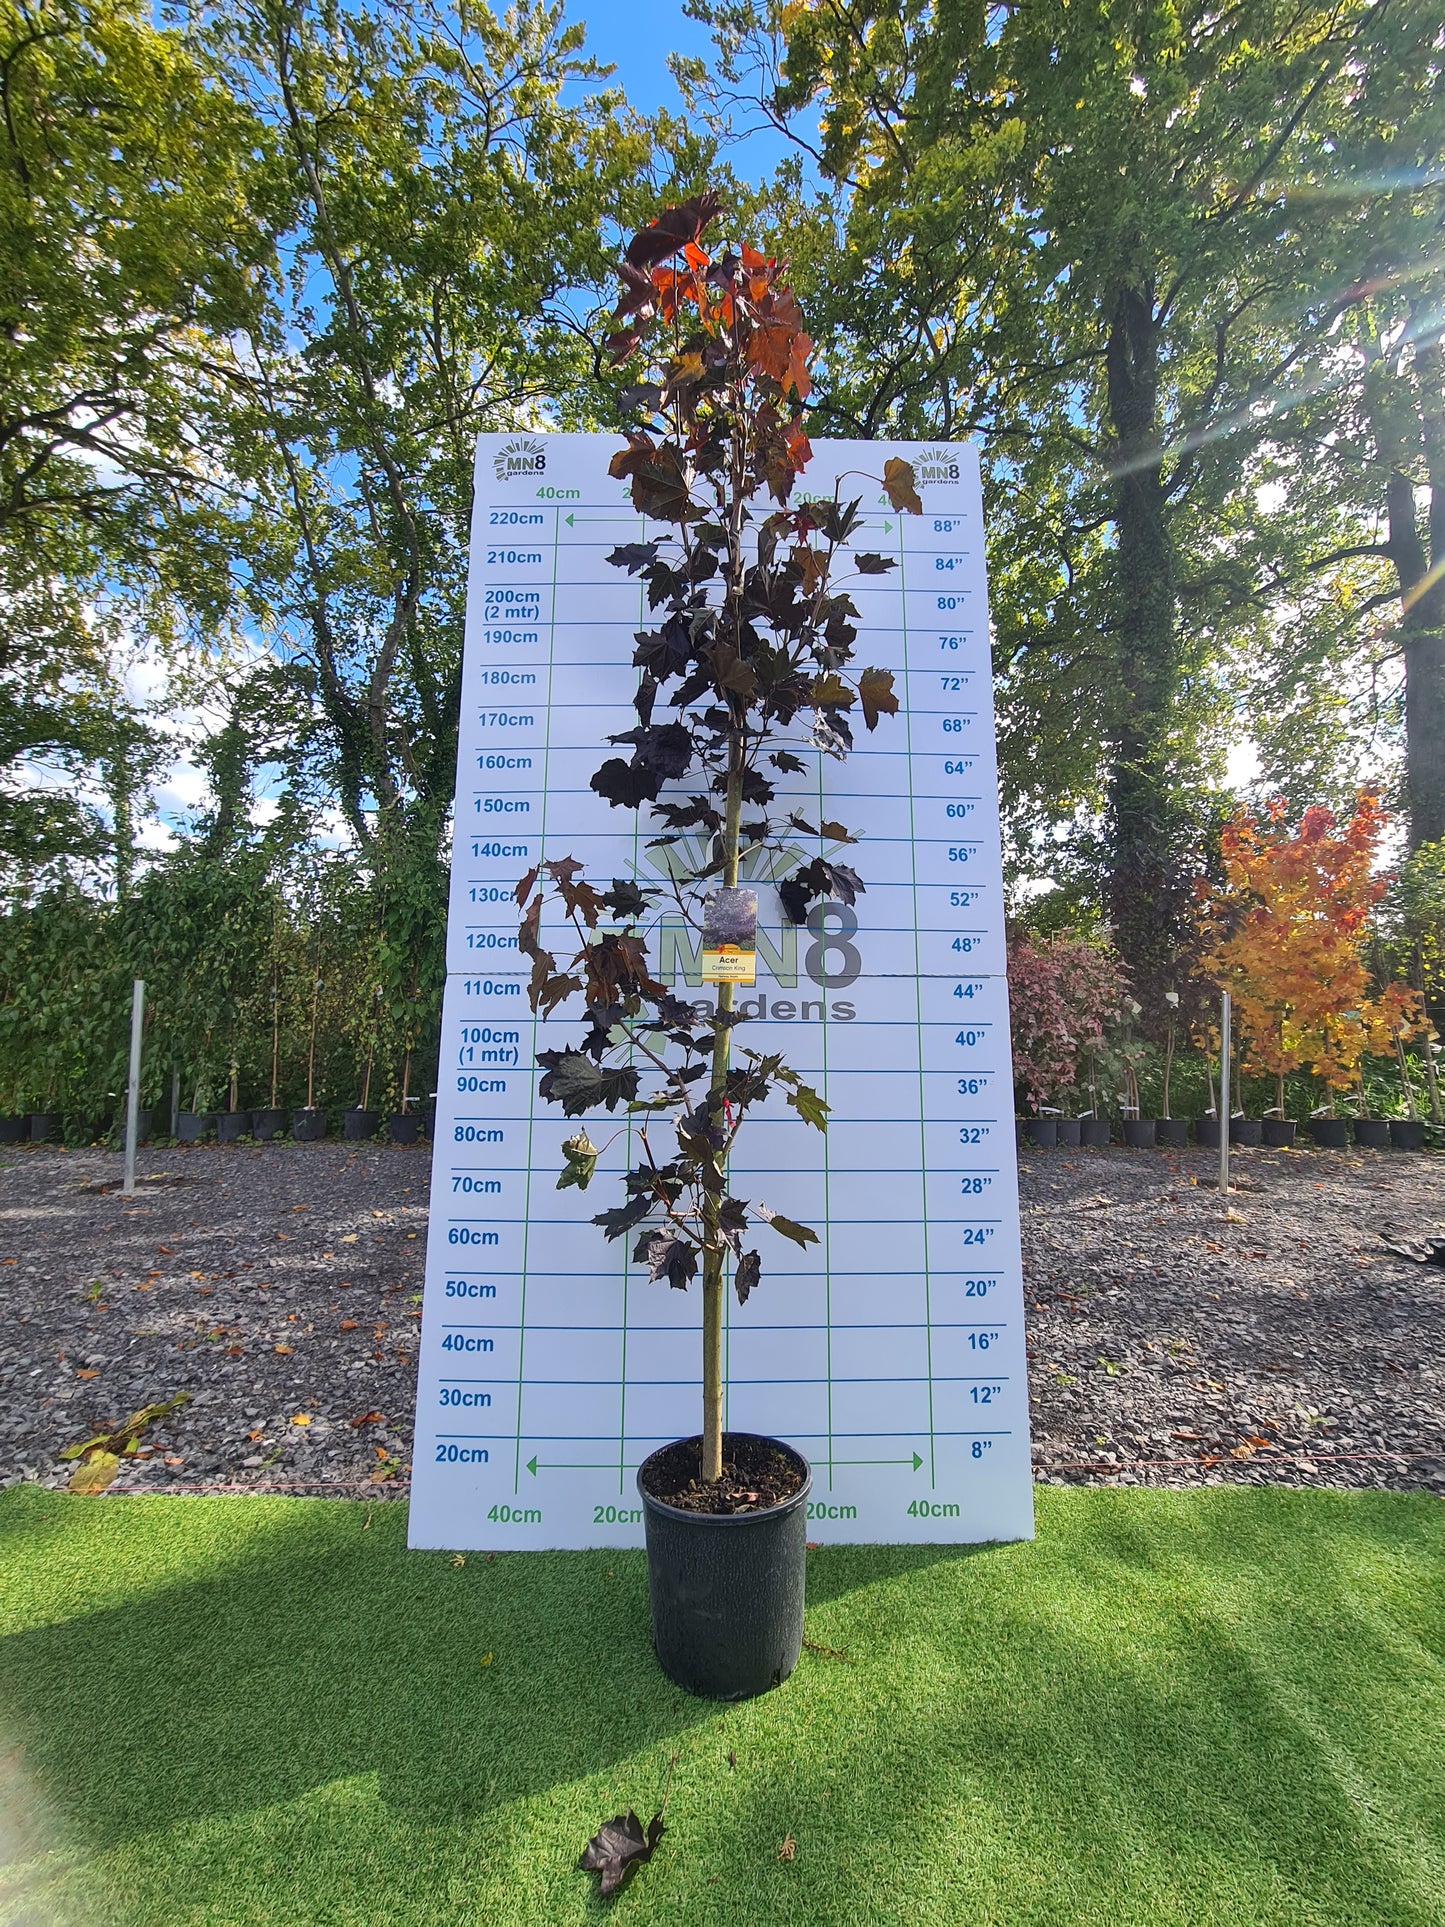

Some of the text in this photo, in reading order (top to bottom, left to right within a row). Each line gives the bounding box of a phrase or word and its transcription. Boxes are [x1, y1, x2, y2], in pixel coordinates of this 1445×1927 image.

[507, 455, 546, 470] MN8
[921, 464, 960, 479] MN8
[535, 487, 579, 498] 40cm
[489, 513, 543, 524] 220cm
[487, 551, 541, 563] 210cm
[485, 591, 539, 603] 200cm
[484, 605, 540, 621] (2 mtr)
[483, 631, 537, 643] 190cm
[481, 672, 535, 684] 180cm
[479, 713, 533, 726] 170cm
[476, 756, 531, 768] 160cm
[474, 799, 529, 812] 150cm
[471, 843, 527, 856] 140cm
[468, 888, 513, 902] 130c
[719, 956, 739, 964] Acer
[463, 981, 520, 995] 110cm
[690, 994, 857, 1021] adens
[461, 1028, 519, 1043] 100cm
[459, 1046, 519, 1066] (1 mtr)
[457, 1077, 505, 1092] 90cm
[454, 1126, 503, 1142] 80cm
[451, 1177, 501, 1193] 70cm
[448, 1228, 498, 1244] 60cm
[445, 1281, 496, 1297] 50cm
[441, 1335, 493, 1351] 40cm
[439, 1389, 491, 1406] 30cm
[435, 1445, 488, 1462] 20cm
[487, 1505, 541, 1522] 40cm
[591, 1506, 644, 1524] 20cm
[805, 1502, 857, 1520] 20cm
[906, 1501, 959, 1517] 40cm
